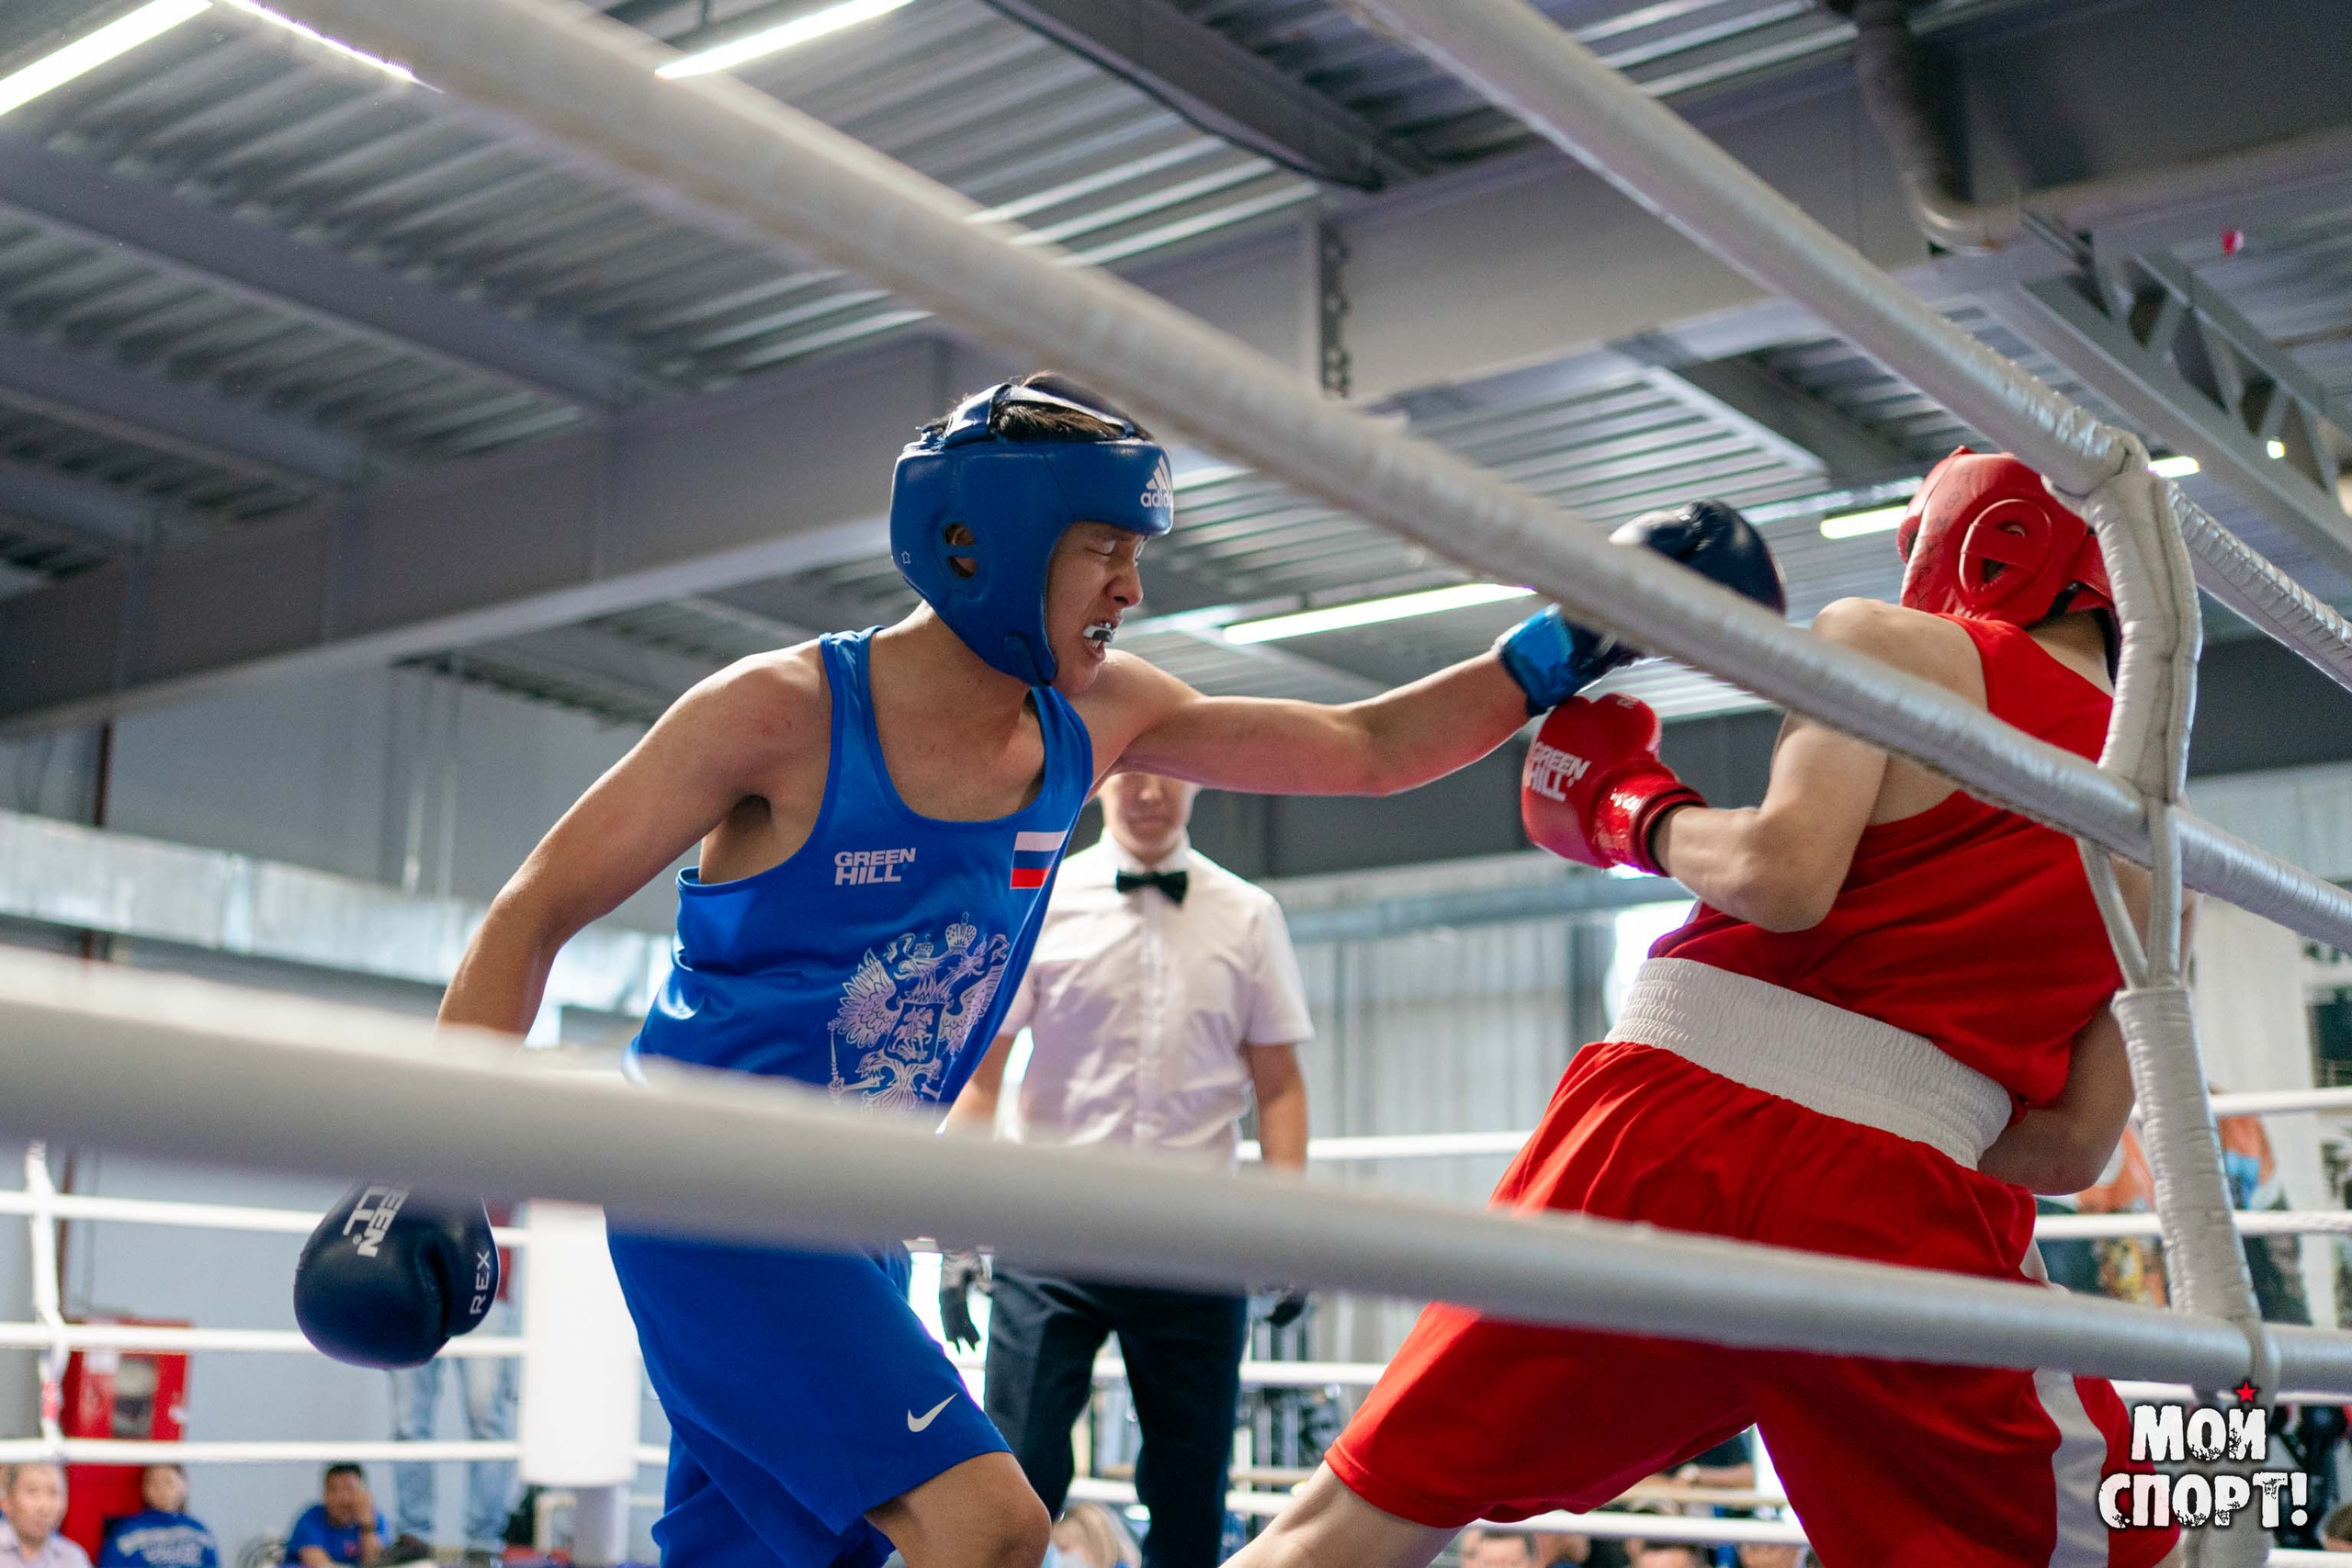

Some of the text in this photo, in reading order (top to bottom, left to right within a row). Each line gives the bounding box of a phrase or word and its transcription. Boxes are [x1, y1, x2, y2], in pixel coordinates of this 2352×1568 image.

[1140, 489, 1173, 508] adid
[1531, 741, 1592, 781] GREEN
[1526, 761, 1566, 803] HILL
[834, 848, 916, 867] GREEN
[834, 864, 902, 886] HILL
[356, 1188, 411, 1258] EEN
[469, 1250, 492, 1315] REX
